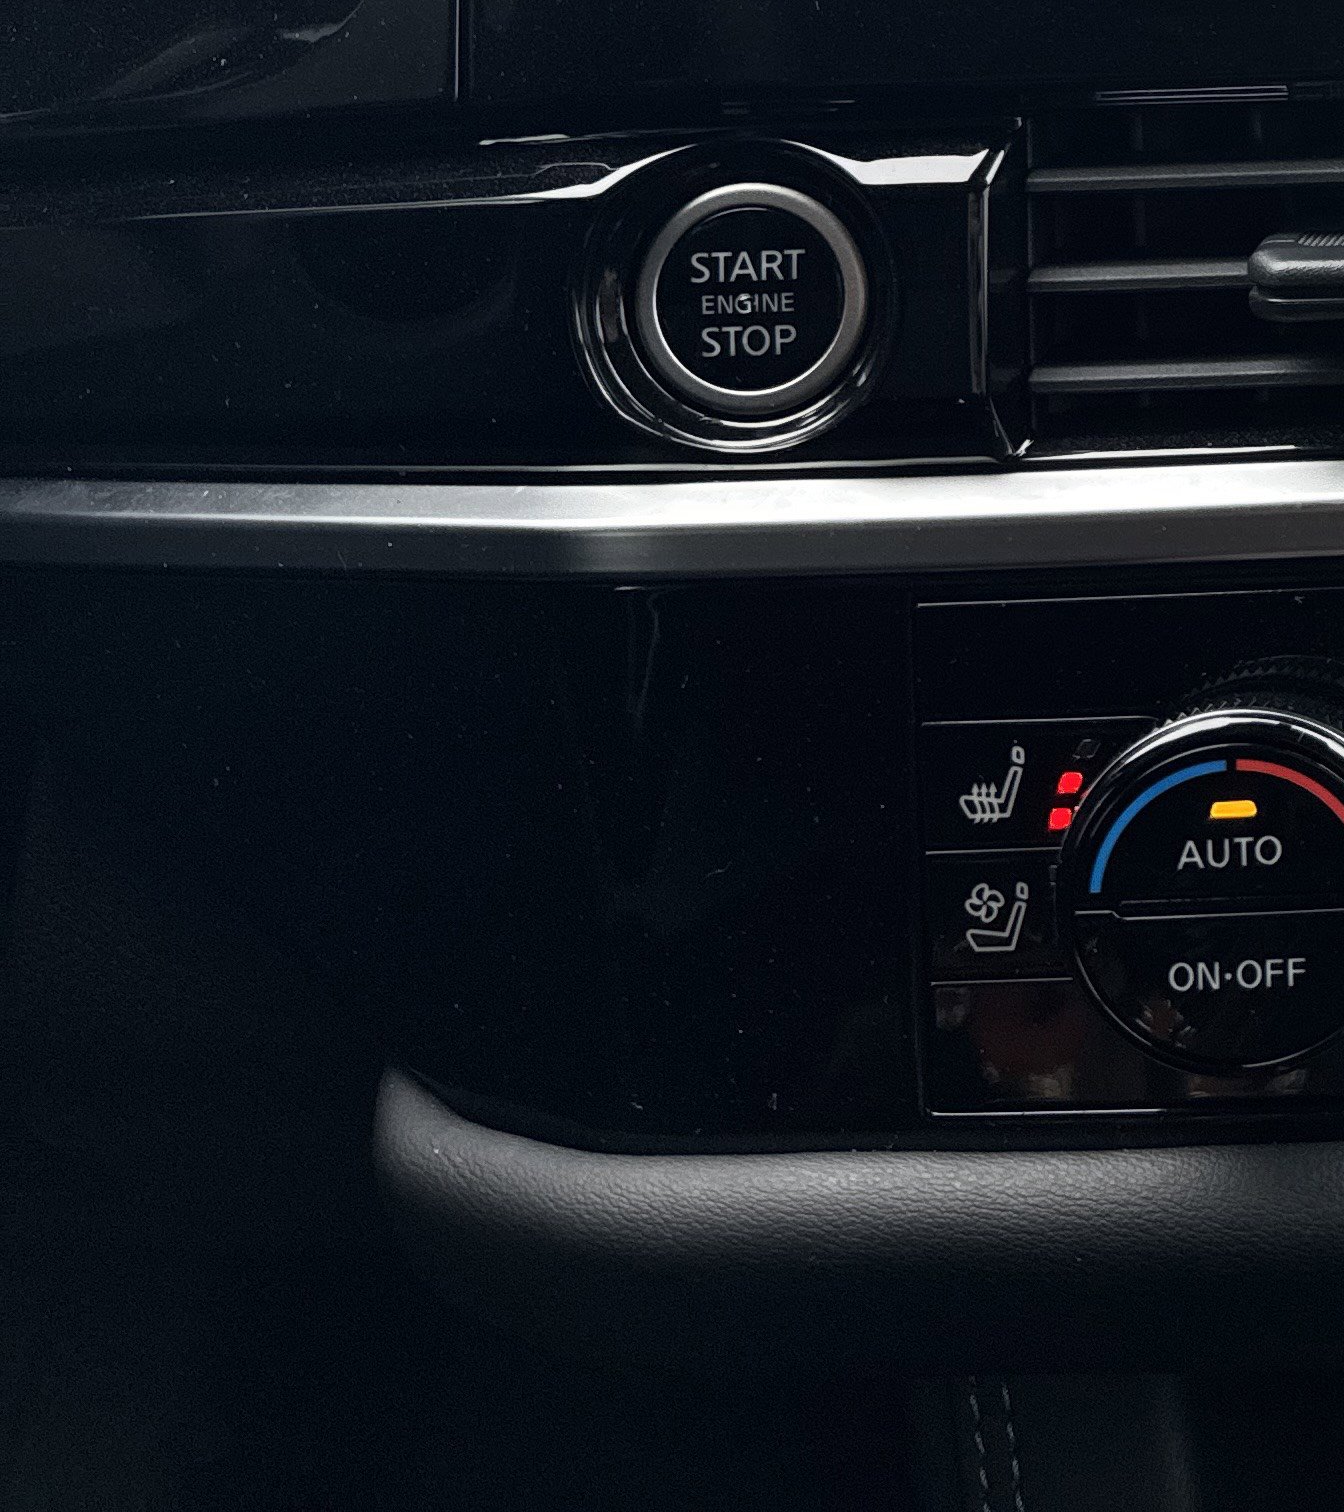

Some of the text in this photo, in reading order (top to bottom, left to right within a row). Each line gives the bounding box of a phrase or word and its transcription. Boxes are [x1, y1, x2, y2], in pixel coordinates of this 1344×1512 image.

[690, 249, 805, 283] START
[701, 292, 795, 315] ENGINE
[702, 325, 797, 357] STOP
[1178, 835, 1283, 870] AUTO
